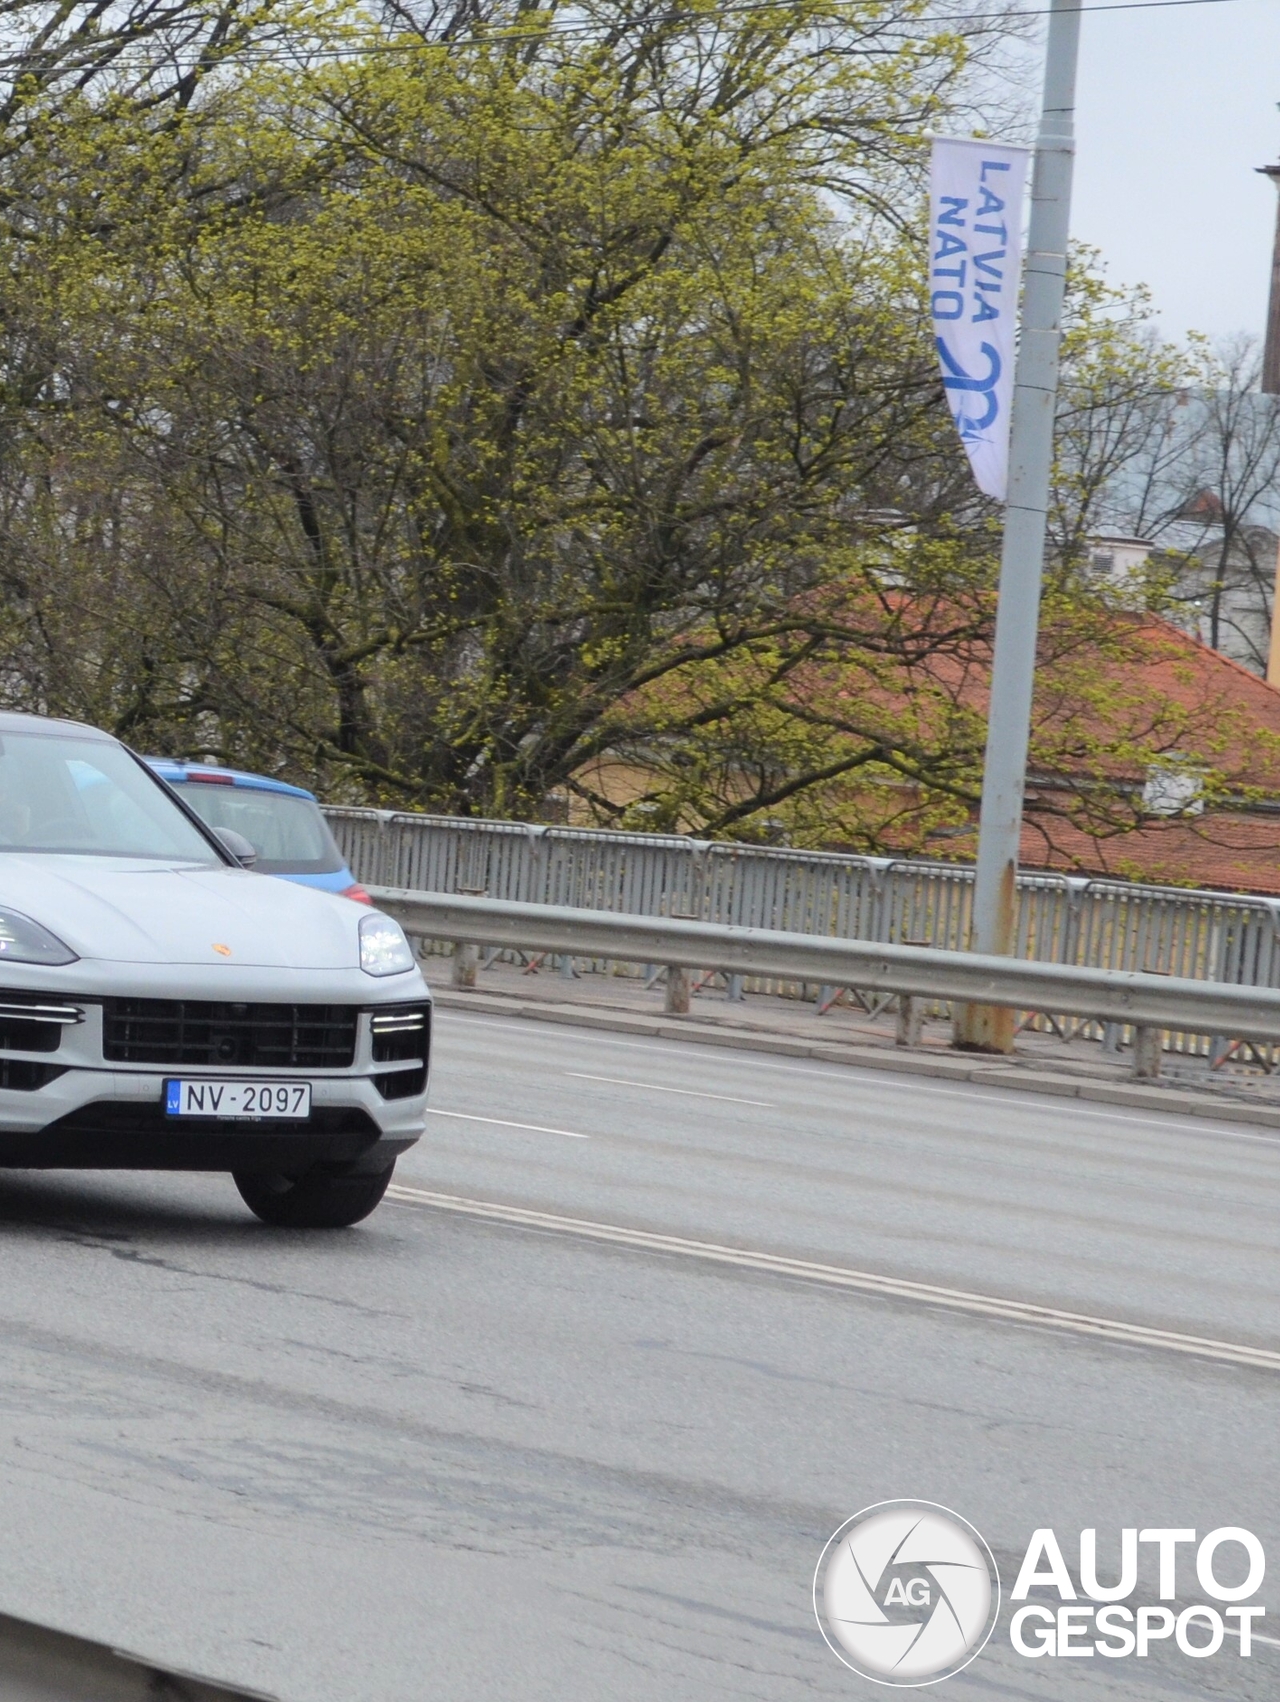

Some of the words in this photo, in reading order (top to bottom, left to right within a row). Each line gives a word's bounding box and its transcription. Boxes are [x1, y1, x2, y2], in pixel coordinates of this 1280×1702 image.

[931, 196, 969, 321] NATO
[971, 160, 1011, 323] LATVIA
[167, 1100, 179, 1109] LV
[187, 1085, 306, 1113] NV-2097
